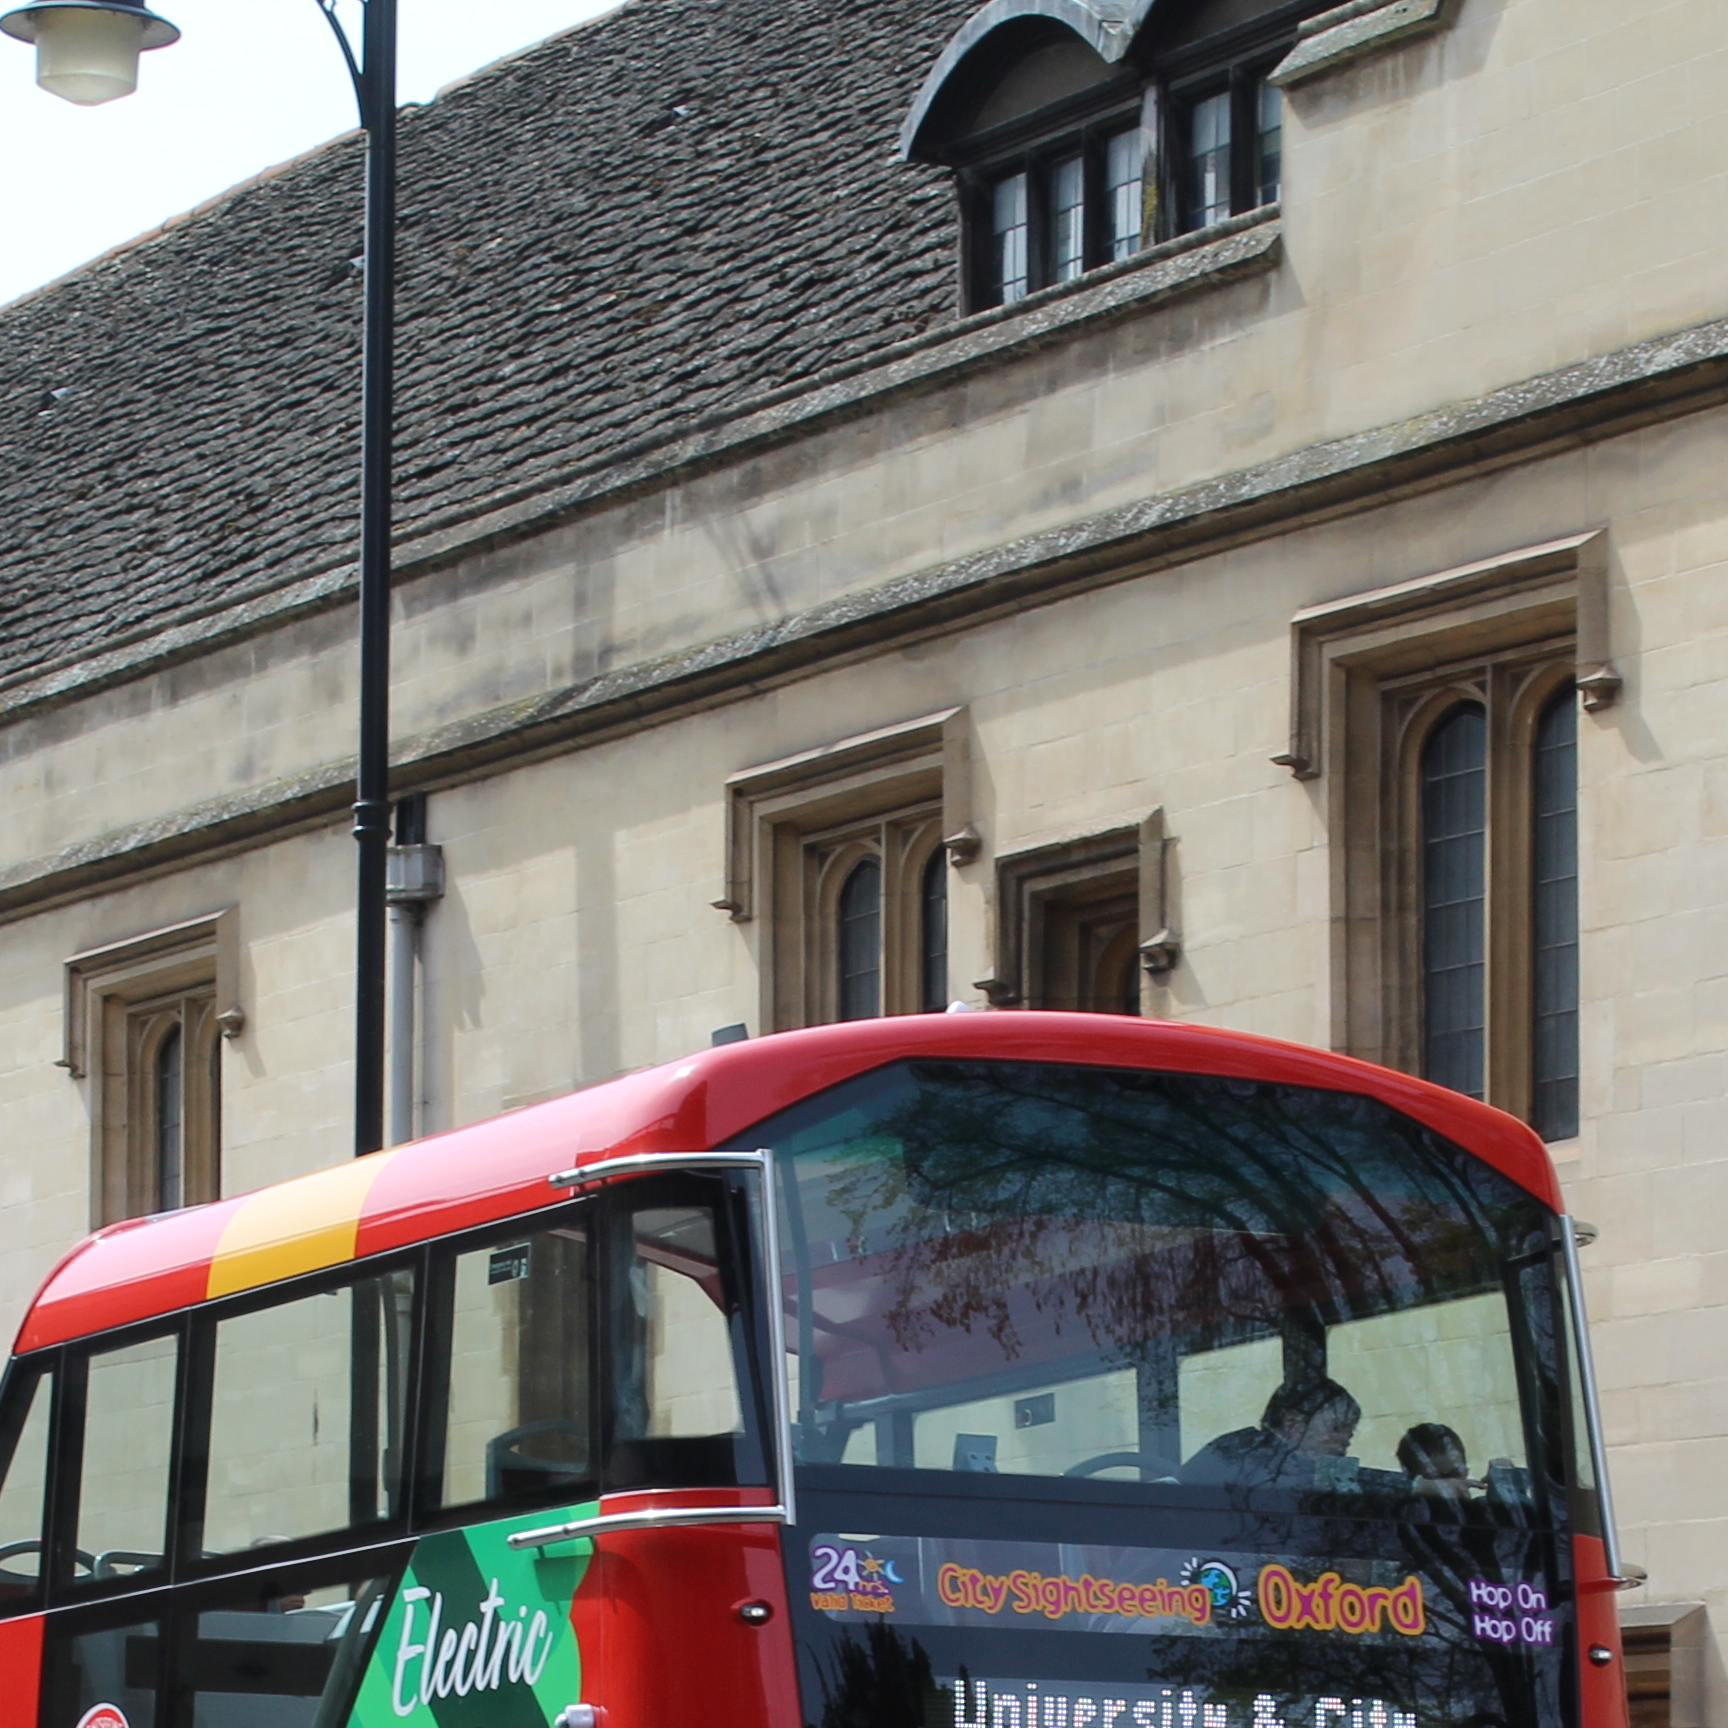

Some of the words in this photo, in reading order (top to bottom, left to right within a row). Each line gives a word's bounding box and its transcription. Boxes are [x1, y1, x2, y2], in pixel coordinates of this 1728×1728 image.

[812, 1547, 862, 1591] 24
[810, 1592, 848, 1611] Valid
[1258, 1564, 1425, 1635] Oxford
[1471, 1580, 1512, 1610] Hop
[1517, 1583, 1547, 1610] On
[391, 1577, 552, 1717] Electric
[1473, 1614, 1516, 1643] Hop
[1522, 1616, 1553, 1643] Off
